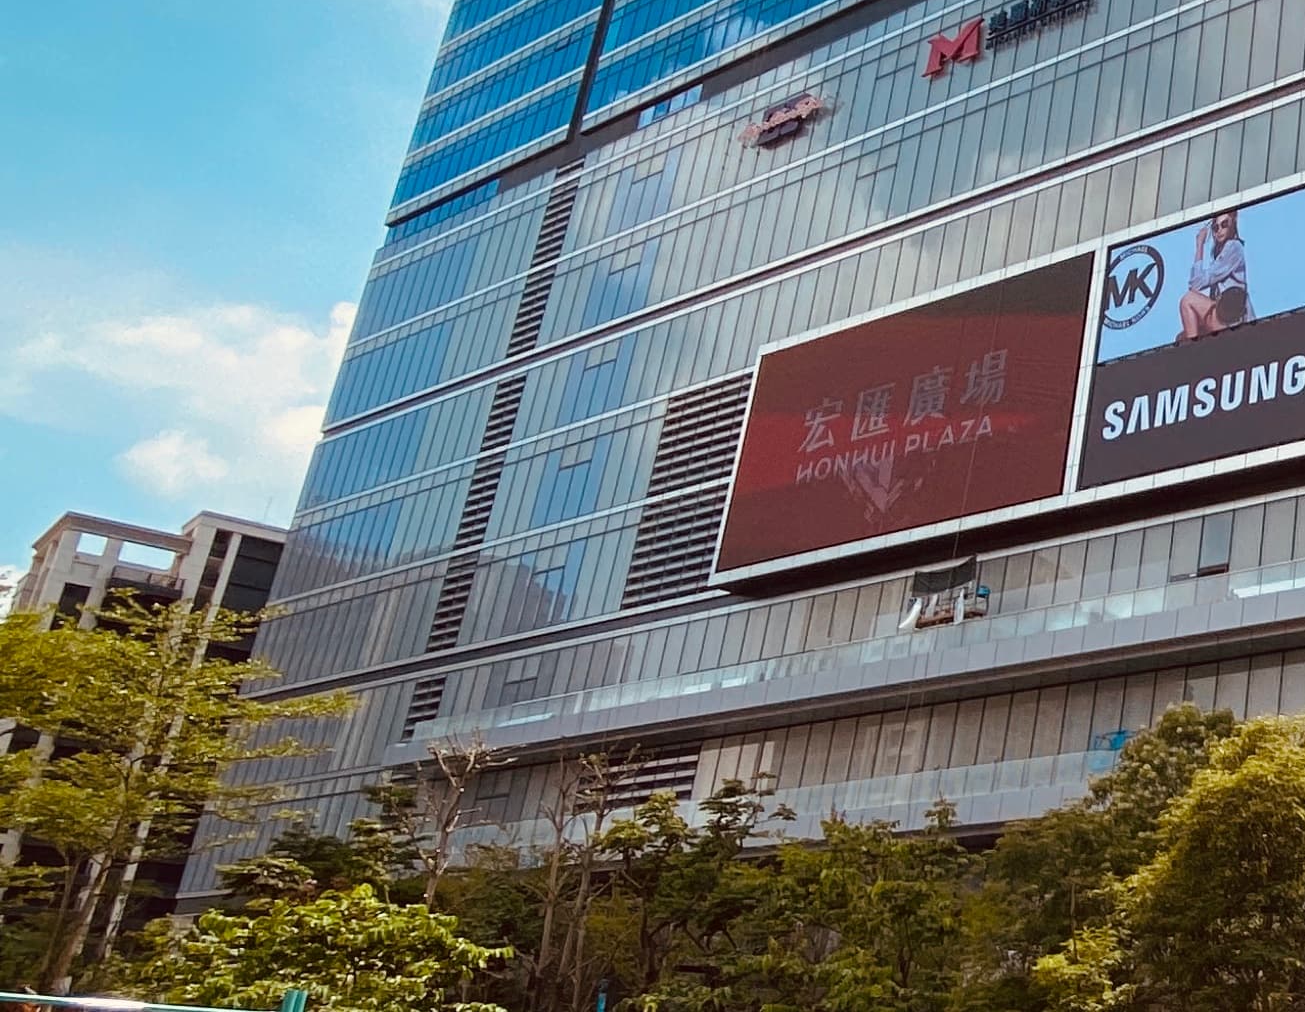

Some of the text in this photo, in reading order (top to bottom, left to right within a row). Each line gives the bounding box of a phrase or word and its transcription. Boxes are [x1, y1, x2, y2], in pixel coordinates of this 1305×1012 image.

[921, 17, 984, 78] M
[797, 348, 1009, 453] 宏匯廣場
[795, 415, 993, 485] HONHUI PLAZA
